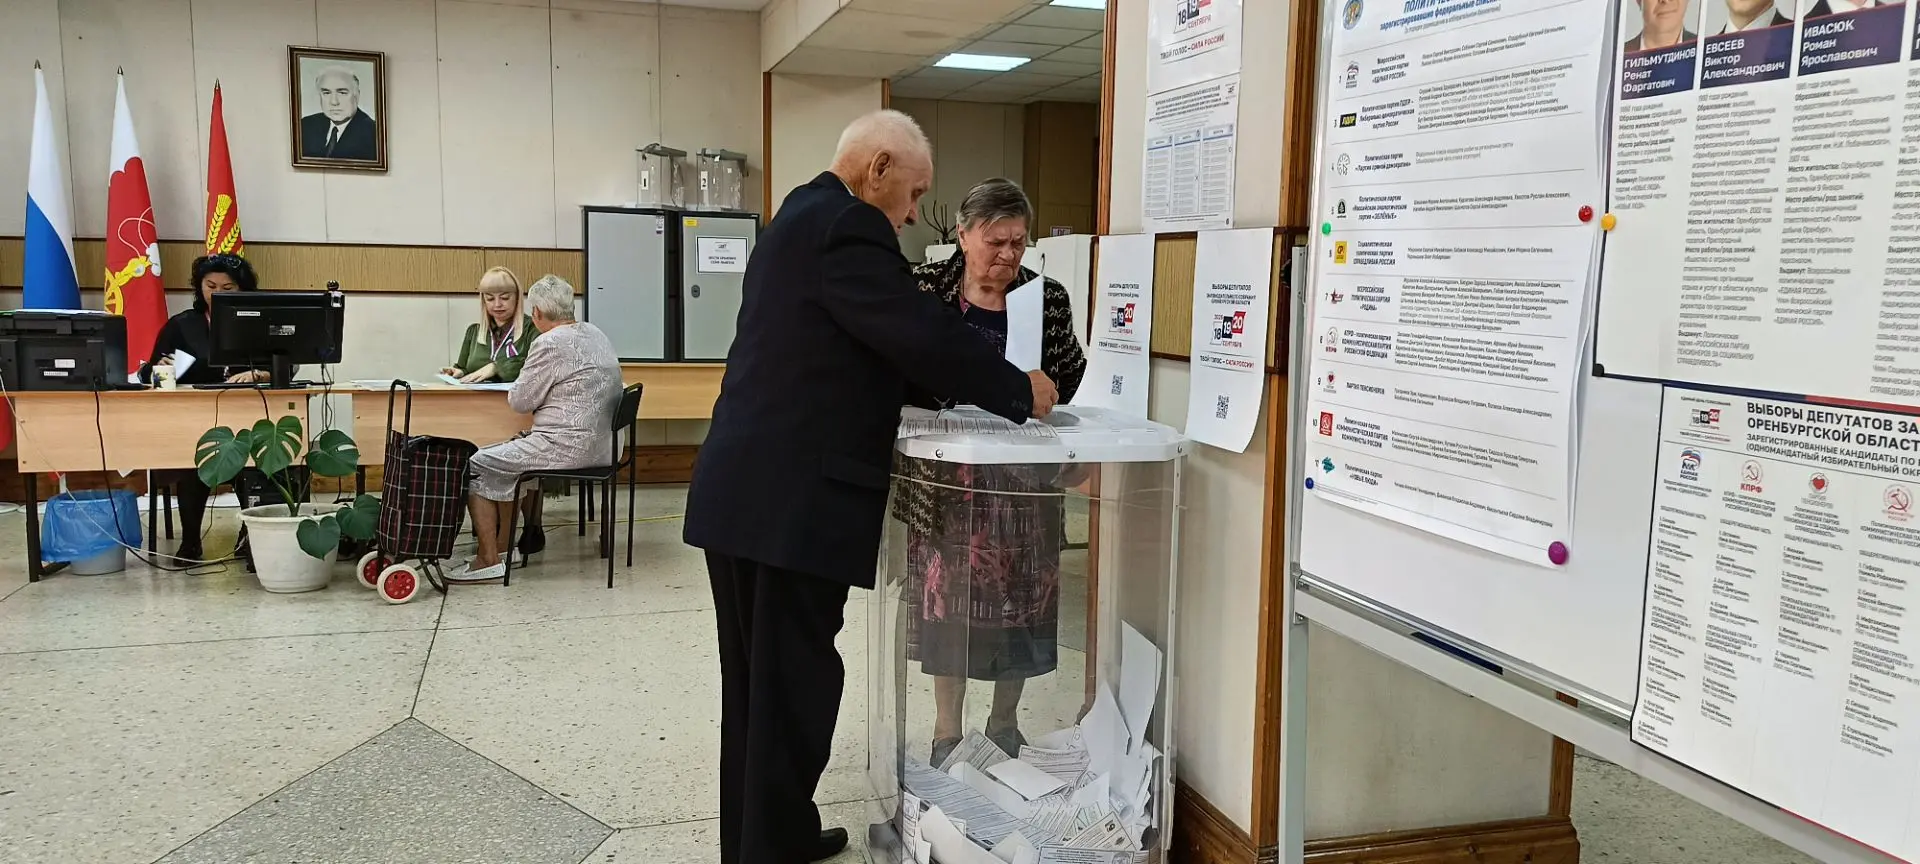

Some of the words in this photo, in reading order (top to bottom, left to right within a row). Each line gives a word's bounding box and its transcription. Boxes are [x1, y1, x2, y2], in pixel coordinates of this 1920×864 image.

[1177, 9, 1187, 26] 18
[1803, 19, 1855, 39] ИВАСЮК
[1172, 45, 1188, 57] ГОЛОС
[1191, 40, 1204, 50] СИЛА
[1705, 38, 1745, 55] ЕВСЕЕВ
[1802, 38, 1837, 52] Роман
[1624, 47, 1696, 69] ГИЛЬМУТДИНОВ
[1704, 53, 1741, 67] Виктор
[1801, 46, 1879, 68] Ярославович
[1624, 70, 1653, 81] Ренат
[1702, 61, 1786, 81] Александрович
[1623, 78, 1676, 94] Фаргатович
[1788, 165, 1804, 173] Место
[1805, 163, 1840, 172] жительства:
[1785, 195, 1801, 204] Место
[1118, 311, 1124, 324] 19
[1124, 306, 1133, 319] 20
[1214, 328, 1222, 340] 18
[1223, 321, 1232, 335] 19
[1232, 316, 1243, 329] 20
[1701, 413, 1709, 422] 19
[1709, 411, 1719, 420] 20
[1747, 402, 1803, 420] ВЫБОРЫ
[1806, 408, 1893, 432] ДЕПУТАТОВ
[1898, 420, 1919, 435] ЗА
[1747, 417, 1851, 444] ОРЕНБУРГСКОЙ
[1856, 431, 1920, 452] ОБЛАСТ
[1747, 434, 1838, 455] ЗАРЕГИСТРИРОВАННЫЕ
[1839, 448, 1898, 464] КАНДИДАТЫ
[1900, 456, 1916, 466] ПО
[1746, 443, 1820, 462] (ОДНОМАНДАТНЫЙ
[1820, 454, 1899, 475] ИЗБИРАТЕЛЬНЫЙ
[1680, 469, 1698, 477] ЕДИНАЯ
[1680, 474, 1698, 482] РОССИЯ
[1740, 482, 1762, 493] КПРФ
